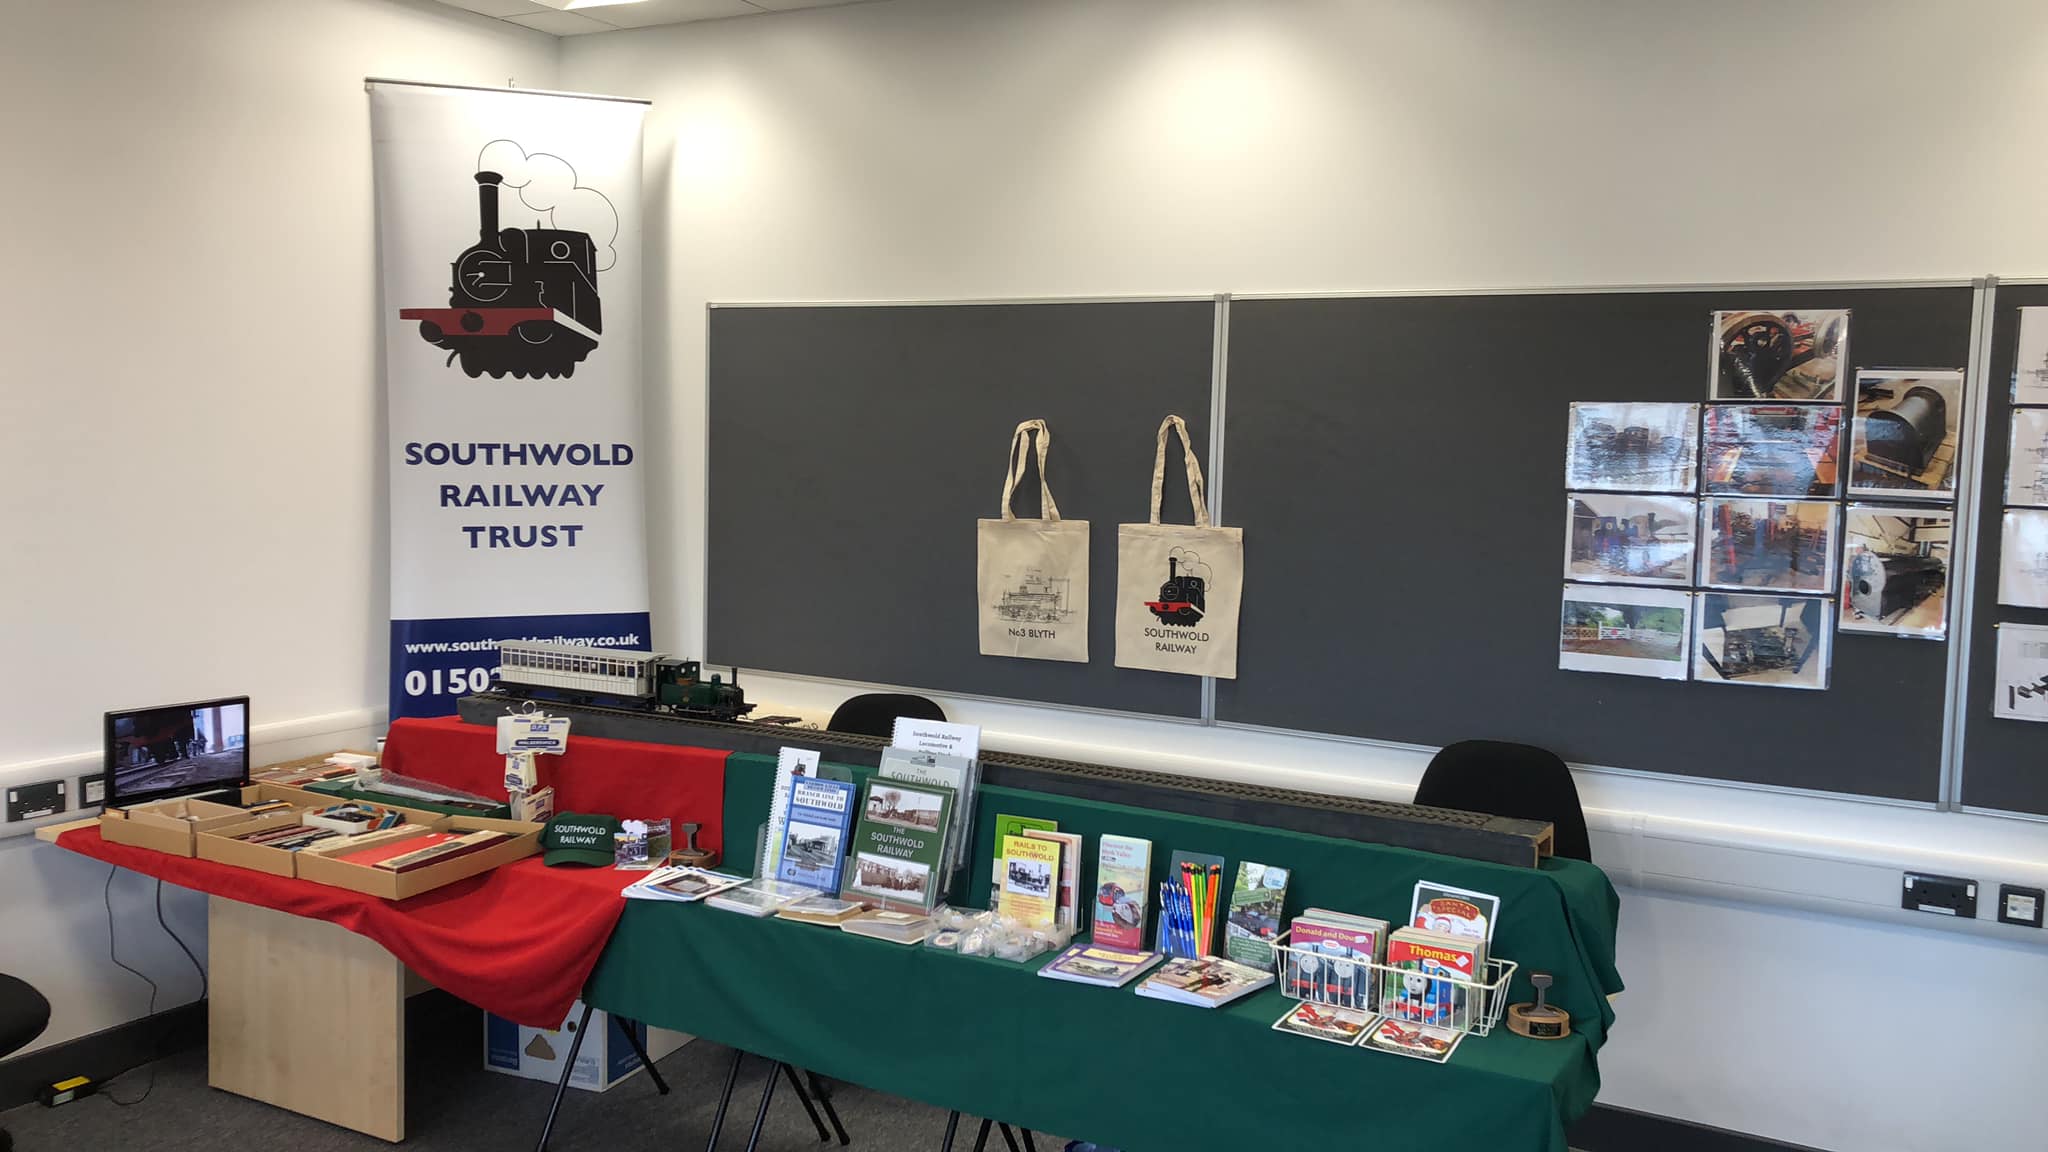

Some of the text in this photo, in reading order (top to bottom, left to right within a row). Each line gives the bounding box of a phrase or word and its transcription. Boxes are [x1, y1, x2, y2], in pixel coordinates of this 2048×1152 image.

[405, 442, 634, 466] SOUTHWOLD
[440, 484, 605, 507] RAILWAY
[462, 525, 584, 549] TRUST
[1008, 628, 1055, 638] No3 BLYTH
[1144, 628, 1209, 641] SOUTHWOLD
[405, 633, 640, 654] www.southailway.co.uk
[1155, 642, 1197, 654] RAILWAY
[795, 796, 844, 810] SOUTHWOLD
[554, 824, 606, 835] SOUTHWOLD
[893, 826, 905, 835] THE
[560, 835, 597, 844] RAILWAY
[871, 831, 925, 849] SOUTHWOLD
[1013, 841, 1048, 852] RAILS TO
[877, 844, 914, 858] RAILWAY
[1006, 848, 1055, 861] SOUTHWOLD
[1295, 925, 1322, 937] Donald
[1322, 931, 1338, 939] and
[1408, 943, 1458, 963] Thomas
